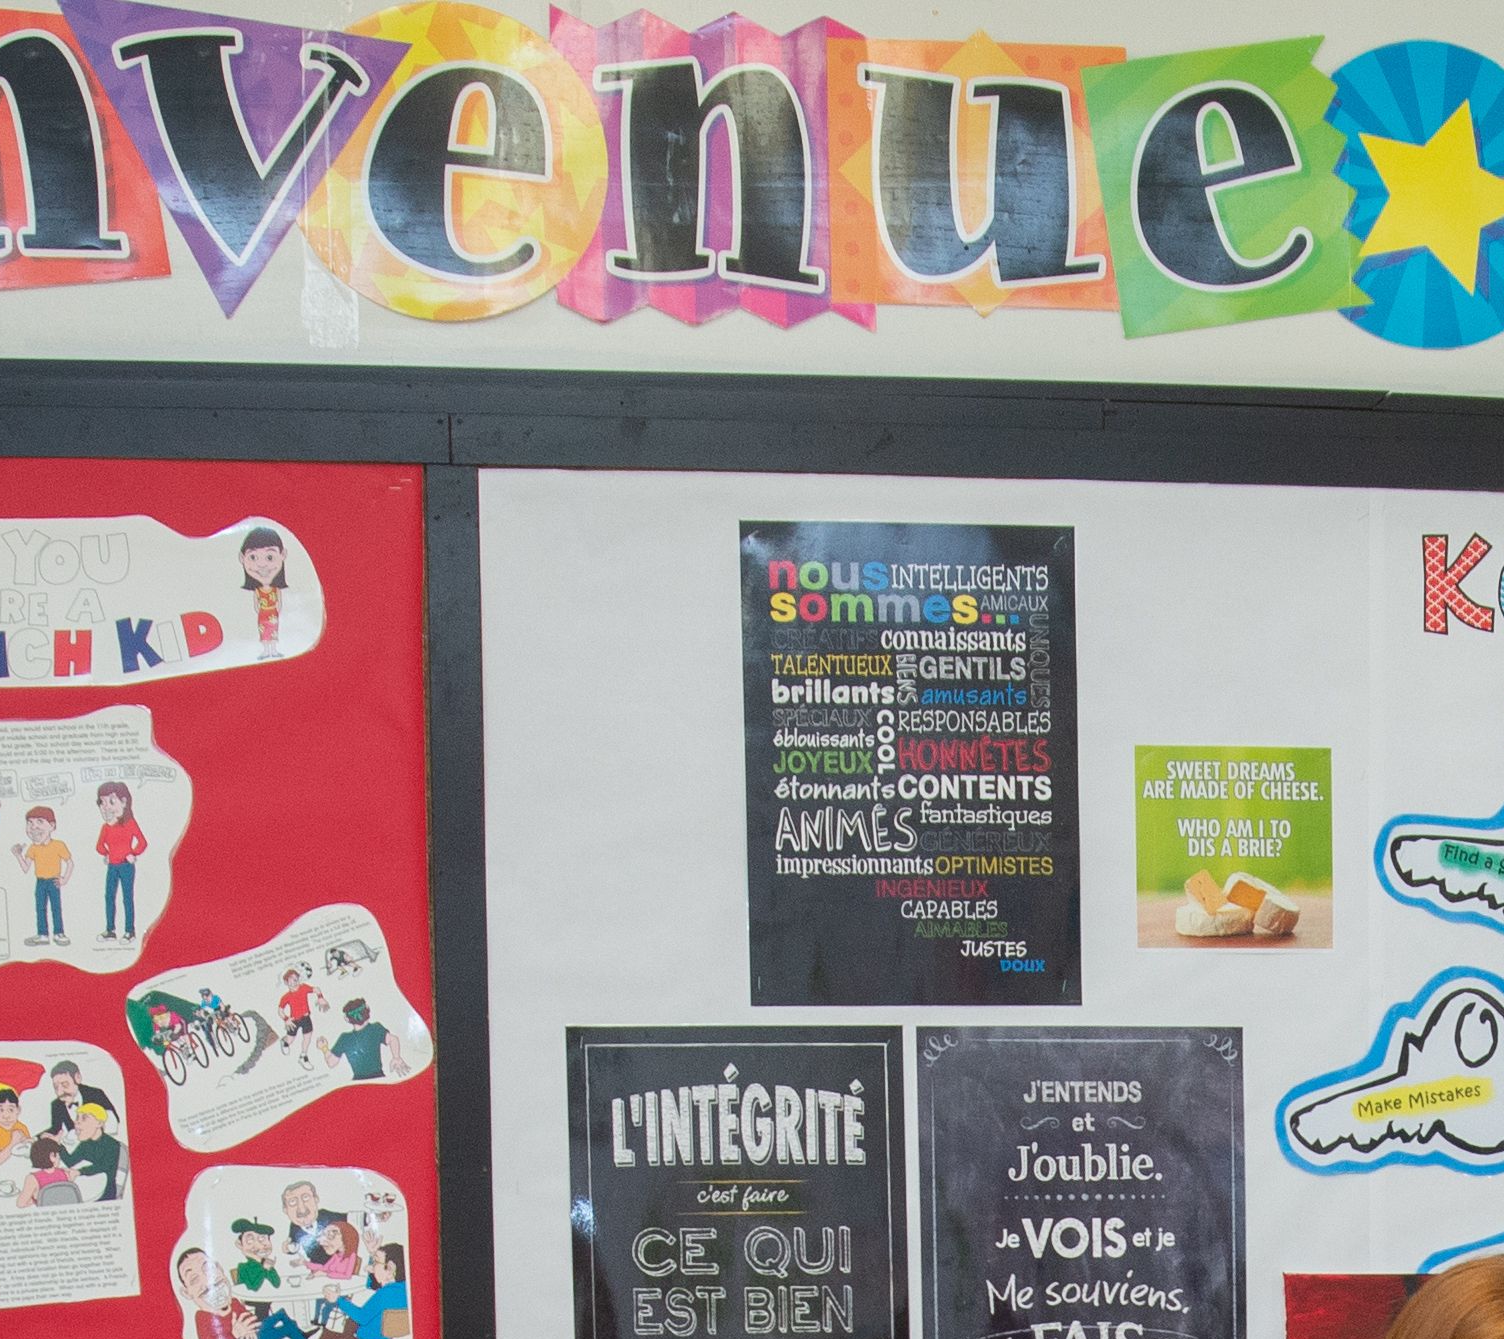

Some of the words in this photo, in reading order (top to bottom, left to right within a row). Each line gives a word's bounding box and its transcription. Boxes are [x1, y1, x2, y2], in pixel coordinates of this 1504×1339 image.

[0, 528, 131, 586] YOU
[768, 560, 889, 590] nous
[891, 563, 1049, 592] INTELLIGENTS
[64, 586, 106, 624] A
[770, 592, 1020, 625] sommes...
[114, 611, 223, 674] KID
[881, 630, 1026, 652] connaissants
[771, 654, 894, 677] TALENTUEUX
[920, 655, 1026, 681] GENTILS
[772, 679, 895, 704] brillants
[897, 710, 1051, 733] RESPONSABLES
[773, 751, 873, 775] JOYEUX
[898, 737, 1052, 773] HONNÊTES
[1167, 761, 1220, 780] SWEET
[1228, 762, 1295, 781] DREAMS
[774, 780, 895, 800] étonnants
[898, 774, 1052, 800] CONTENTS
[1143, 780, 1174, 799] ARE
[1180, 781, 1228, 800] MADE
[1234, 781, 1255, 799] OF
[1261, 782, 1324, 801] CHEESE.
[775, 804, 917, 852] ANIMÉS
[920, 804, 1053, 831] fantastiques
[1177, 819, 1220, 838] WHO
[1226, 819, 1253, 838] AM
[1259, 819, 1263, 837] I
[1270, 819, 1291, 838] TO
[1189, 838, 1215, 857] DIS
[1220, 839, 1232, 857] A
[1238, 839, 1282, 857] BRIE?
[935, 856, 1054, 875] OPTIMISTES
[1023, 1080, 1142, 1104] J'ENTENDS
[1358, 1098, 1402, 1118] Make
[1408, 1083, 1481, 1108] Mistakes
[611, 1062, 867, 1167] L'INTÉGRITÉ
[1071, 1113, 1095, 1132] et
[1008, 1143, 1163, 1182] J'oublie.
[697, 1185, 738, 1204] c'est
[742, 1185, 790, 1211] faire
[632, 1226, 721, 1277] CE
[744, 1225, 852, 1277] QUI
[996, 1230, 1020, 1249] Je
[1021, 1217, 1127, 1259] VOIS
[1132, 1229, 1152, 1247] et
[1156, 1229, 1175, 1251] je
[986, 1273, 1034, 1315] Me
[1045, 1270, 1190, 1314] souviens.
[632, 1285, 727, 1337] EST
[744, 1285, 854, 1334] BIEN
